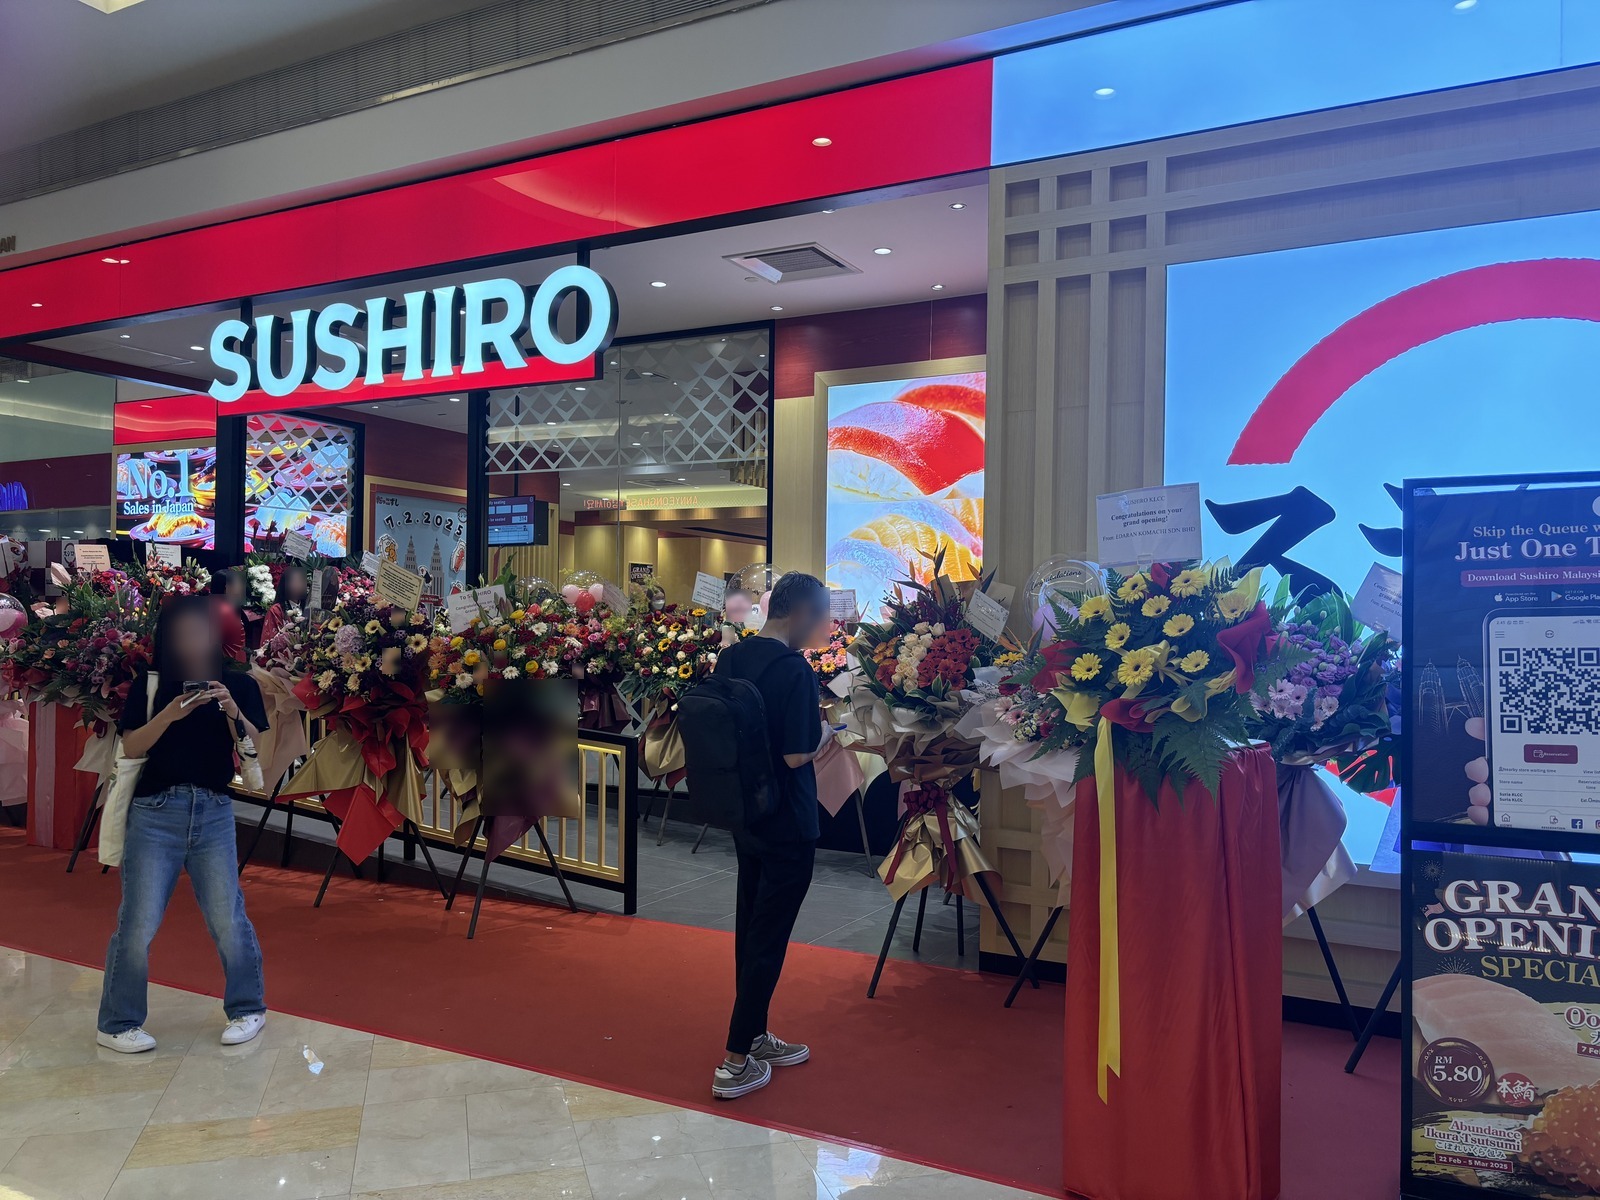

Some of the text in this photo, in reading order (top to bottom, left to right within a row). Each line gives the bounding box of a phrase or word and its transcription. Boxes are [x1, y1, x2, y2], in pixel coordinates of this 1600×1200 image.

[208, 265, 613, 402] SUSHIRO
[126, 450, 194, 500] No.1
[123, 501, 194, 515] Sales in Japan
[1110, 509, 1157, 521] Congratulations
[1167, 507, 1183, 517] your
[384, 511, 464, 537] 7.2.2025
[1122, 515, 1168, 528] grand opening!
[1473, 526, 1506, 538] Skip
[1511, 525, 1534, 536] the
[1538, 523, 1588, 535] Queue
[1138, 529, 1167, 537] KOMACHI
[1454, 541, 1512, 561] Just
[1521, 538, 1577, 558] One
[1467, 570, 1600, 582] Download Sushiro Malaysi
[467, 590, 492, 599] SHIRO
[1444, 880, 1600, 922] GRAN
[1424, 917, 1597, 959] OPENI
[1481, 955, 1600, 987] SPECIA
[1435, 1056, 1453, 1064] RM
[1432, 1065, 1482, 1082] 5.80
[1497, 1078, 1535, 1102] 本鮪
[1426, 1127, 1521, 1151] Ikura Tsutsumi
[1450, 1120, 1521, 1139] Abundance
